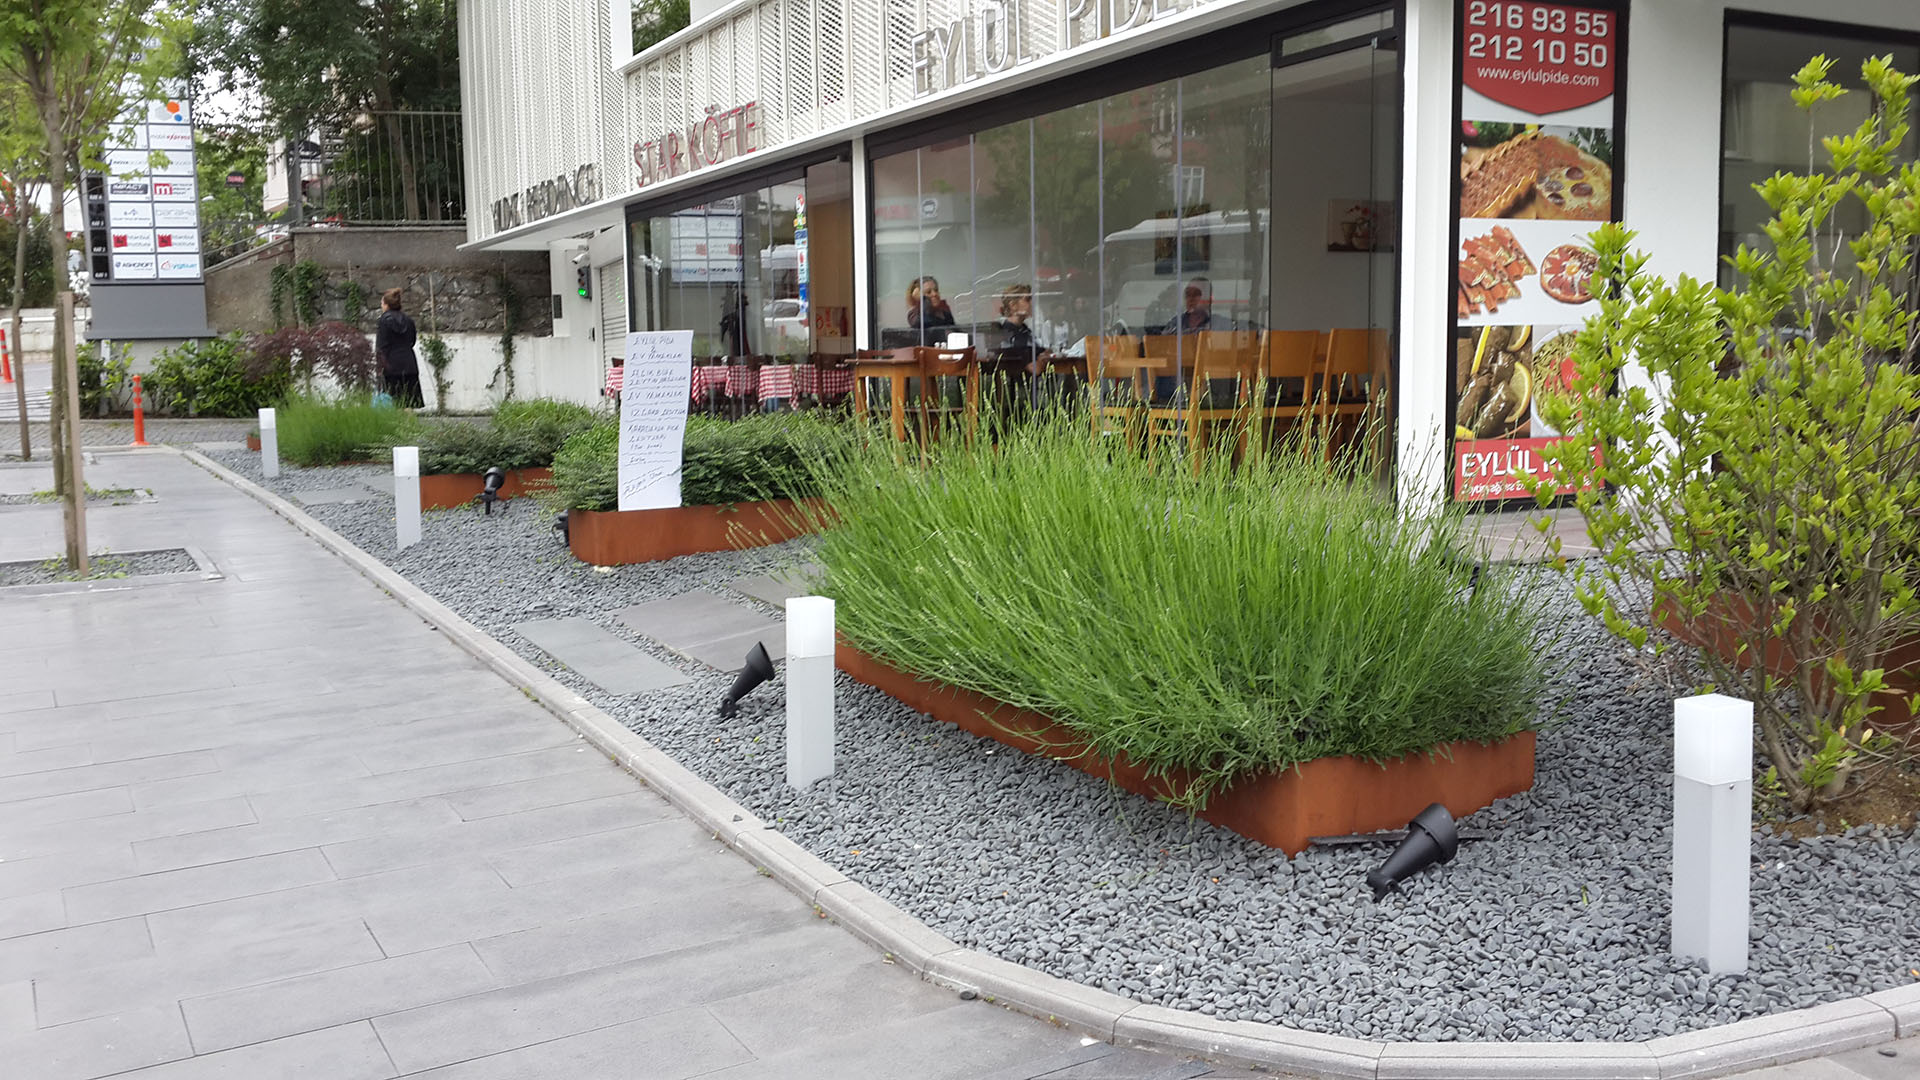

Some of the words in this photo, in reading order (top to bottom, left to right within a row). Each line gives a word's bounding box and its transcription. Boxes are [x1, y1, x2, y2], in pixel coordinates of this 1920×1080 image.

[1469, 1, 1524, 29] 216
[1532, 7, 1567, 34] 93
[1574, 11, 1608, 37] 55
[1469, 33, 1523, 61] 212
[1532, 39, 1566, 64] 10
[1574, 42, 1608, 68] 50
[1477, 66, 1600, 87] www.eylulpide.com
[633, 131, 684, 188] STAR
[686, 100, 763, 172] KÖFTE
[1462, 445, 1538, 477] EYLÜL
